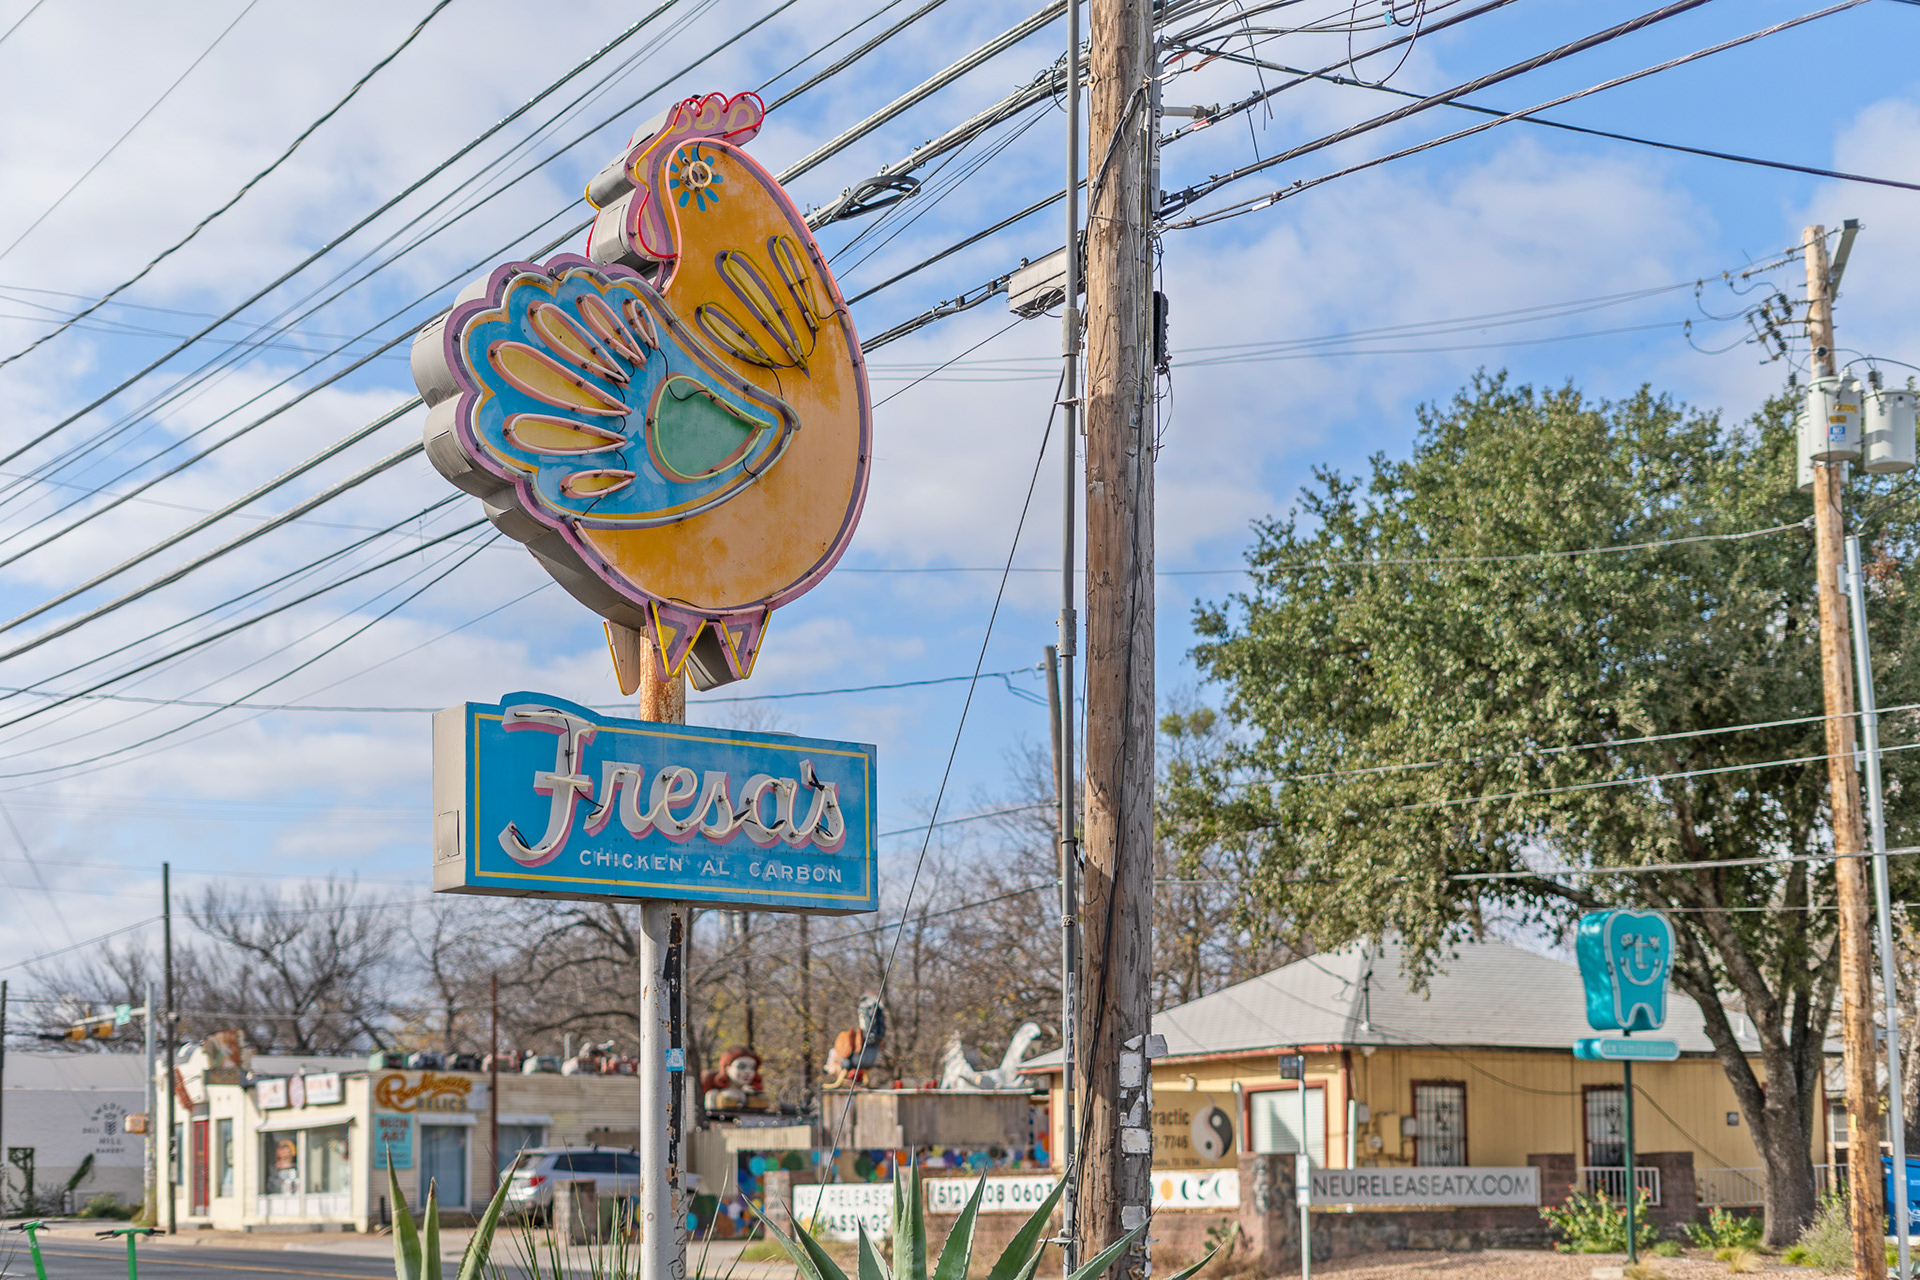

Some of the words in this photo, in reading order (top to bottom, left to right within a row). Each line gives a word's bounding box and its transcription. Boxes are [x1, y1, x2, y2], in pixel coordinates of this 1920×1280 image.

[498, 704, 847, 868] Fresa's
[579, 850, 683, 872] CHICKEN
[701, 859, 730, 876] AL
[749, 861, 842, 883] CARBON
[416, 1097, 467, 1111] RELICS
[1151, 1108, 1190, 1126] ractic
[1153, 1134, 1189, 1149] 1-7746
[1312, 1174, 1532, 1197] NEURELEASEATX.COM
